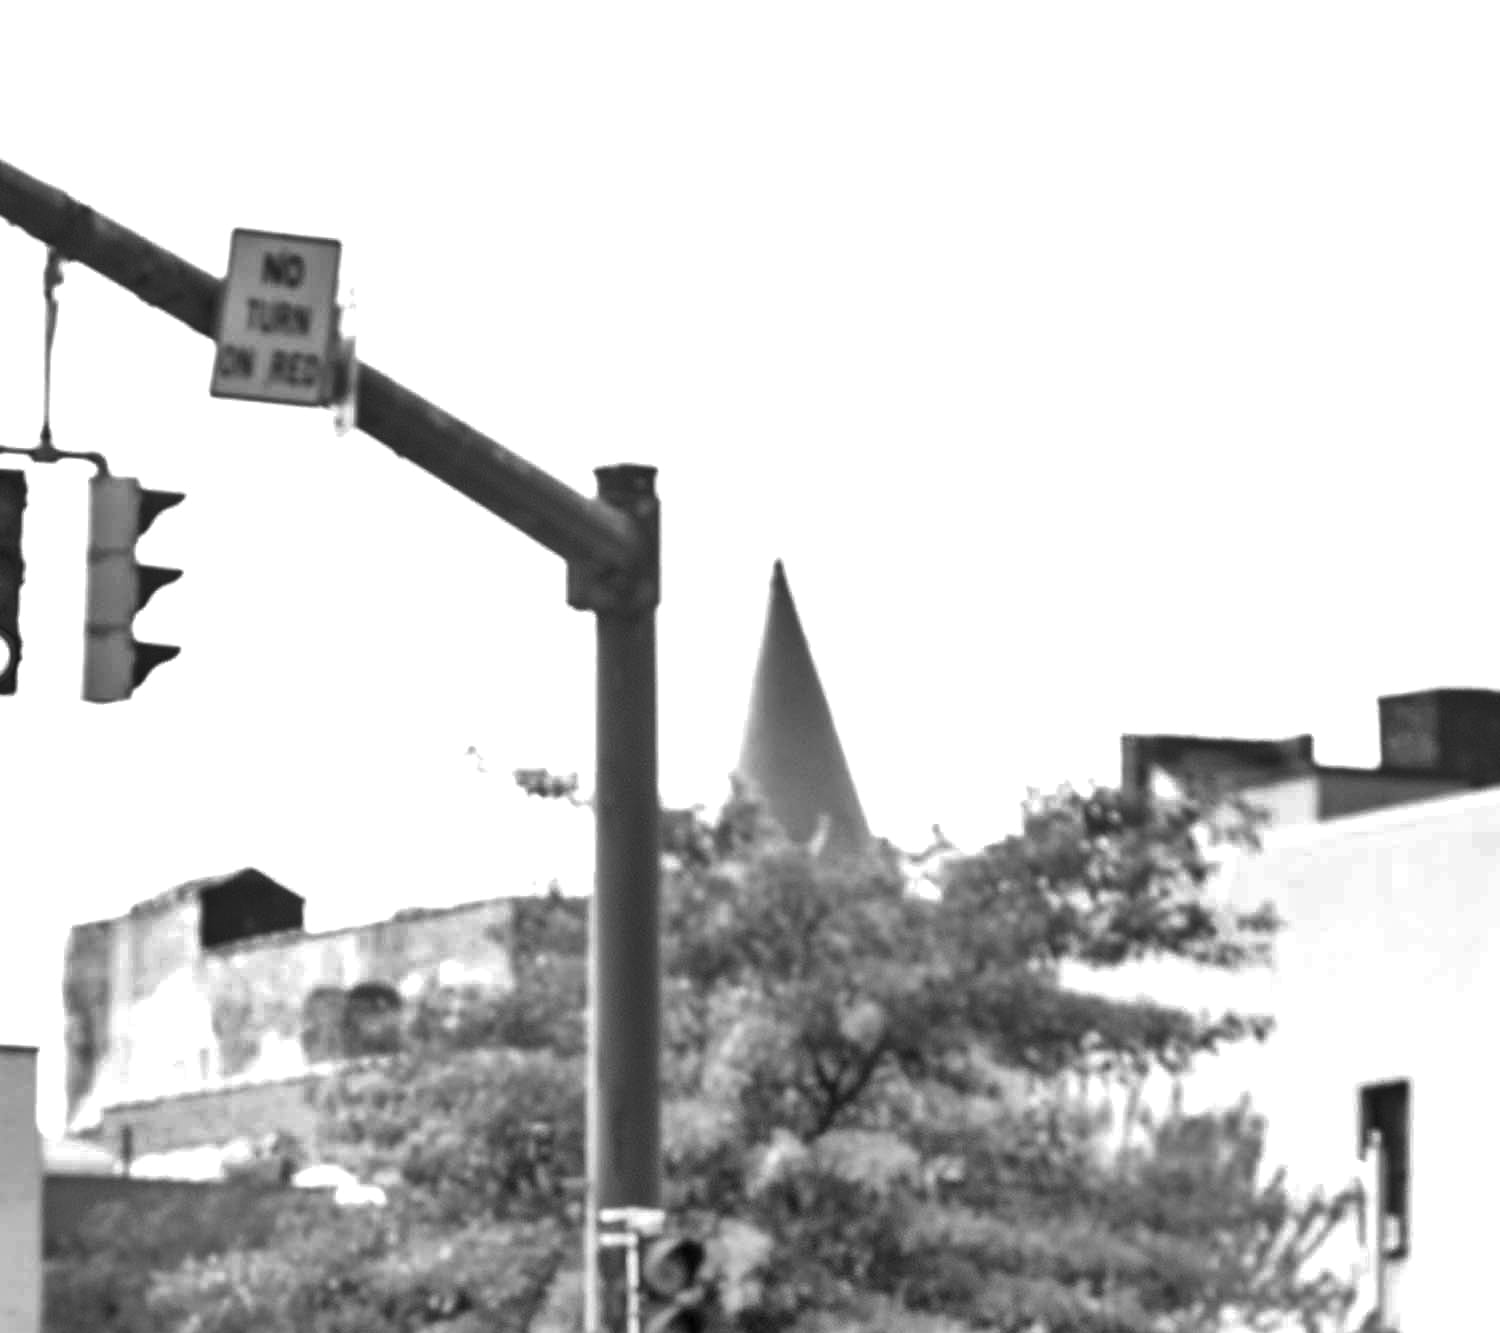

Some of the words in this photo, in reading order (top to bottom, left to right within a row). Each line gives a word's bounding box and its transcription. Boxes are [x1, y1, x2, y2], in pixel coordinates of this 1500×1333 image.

[261, 253, 306, 289] NO
[248, 298, 311, 335] TURN
[219, 346, 254, 379] ON
[271, 350, 319, 388] RED
